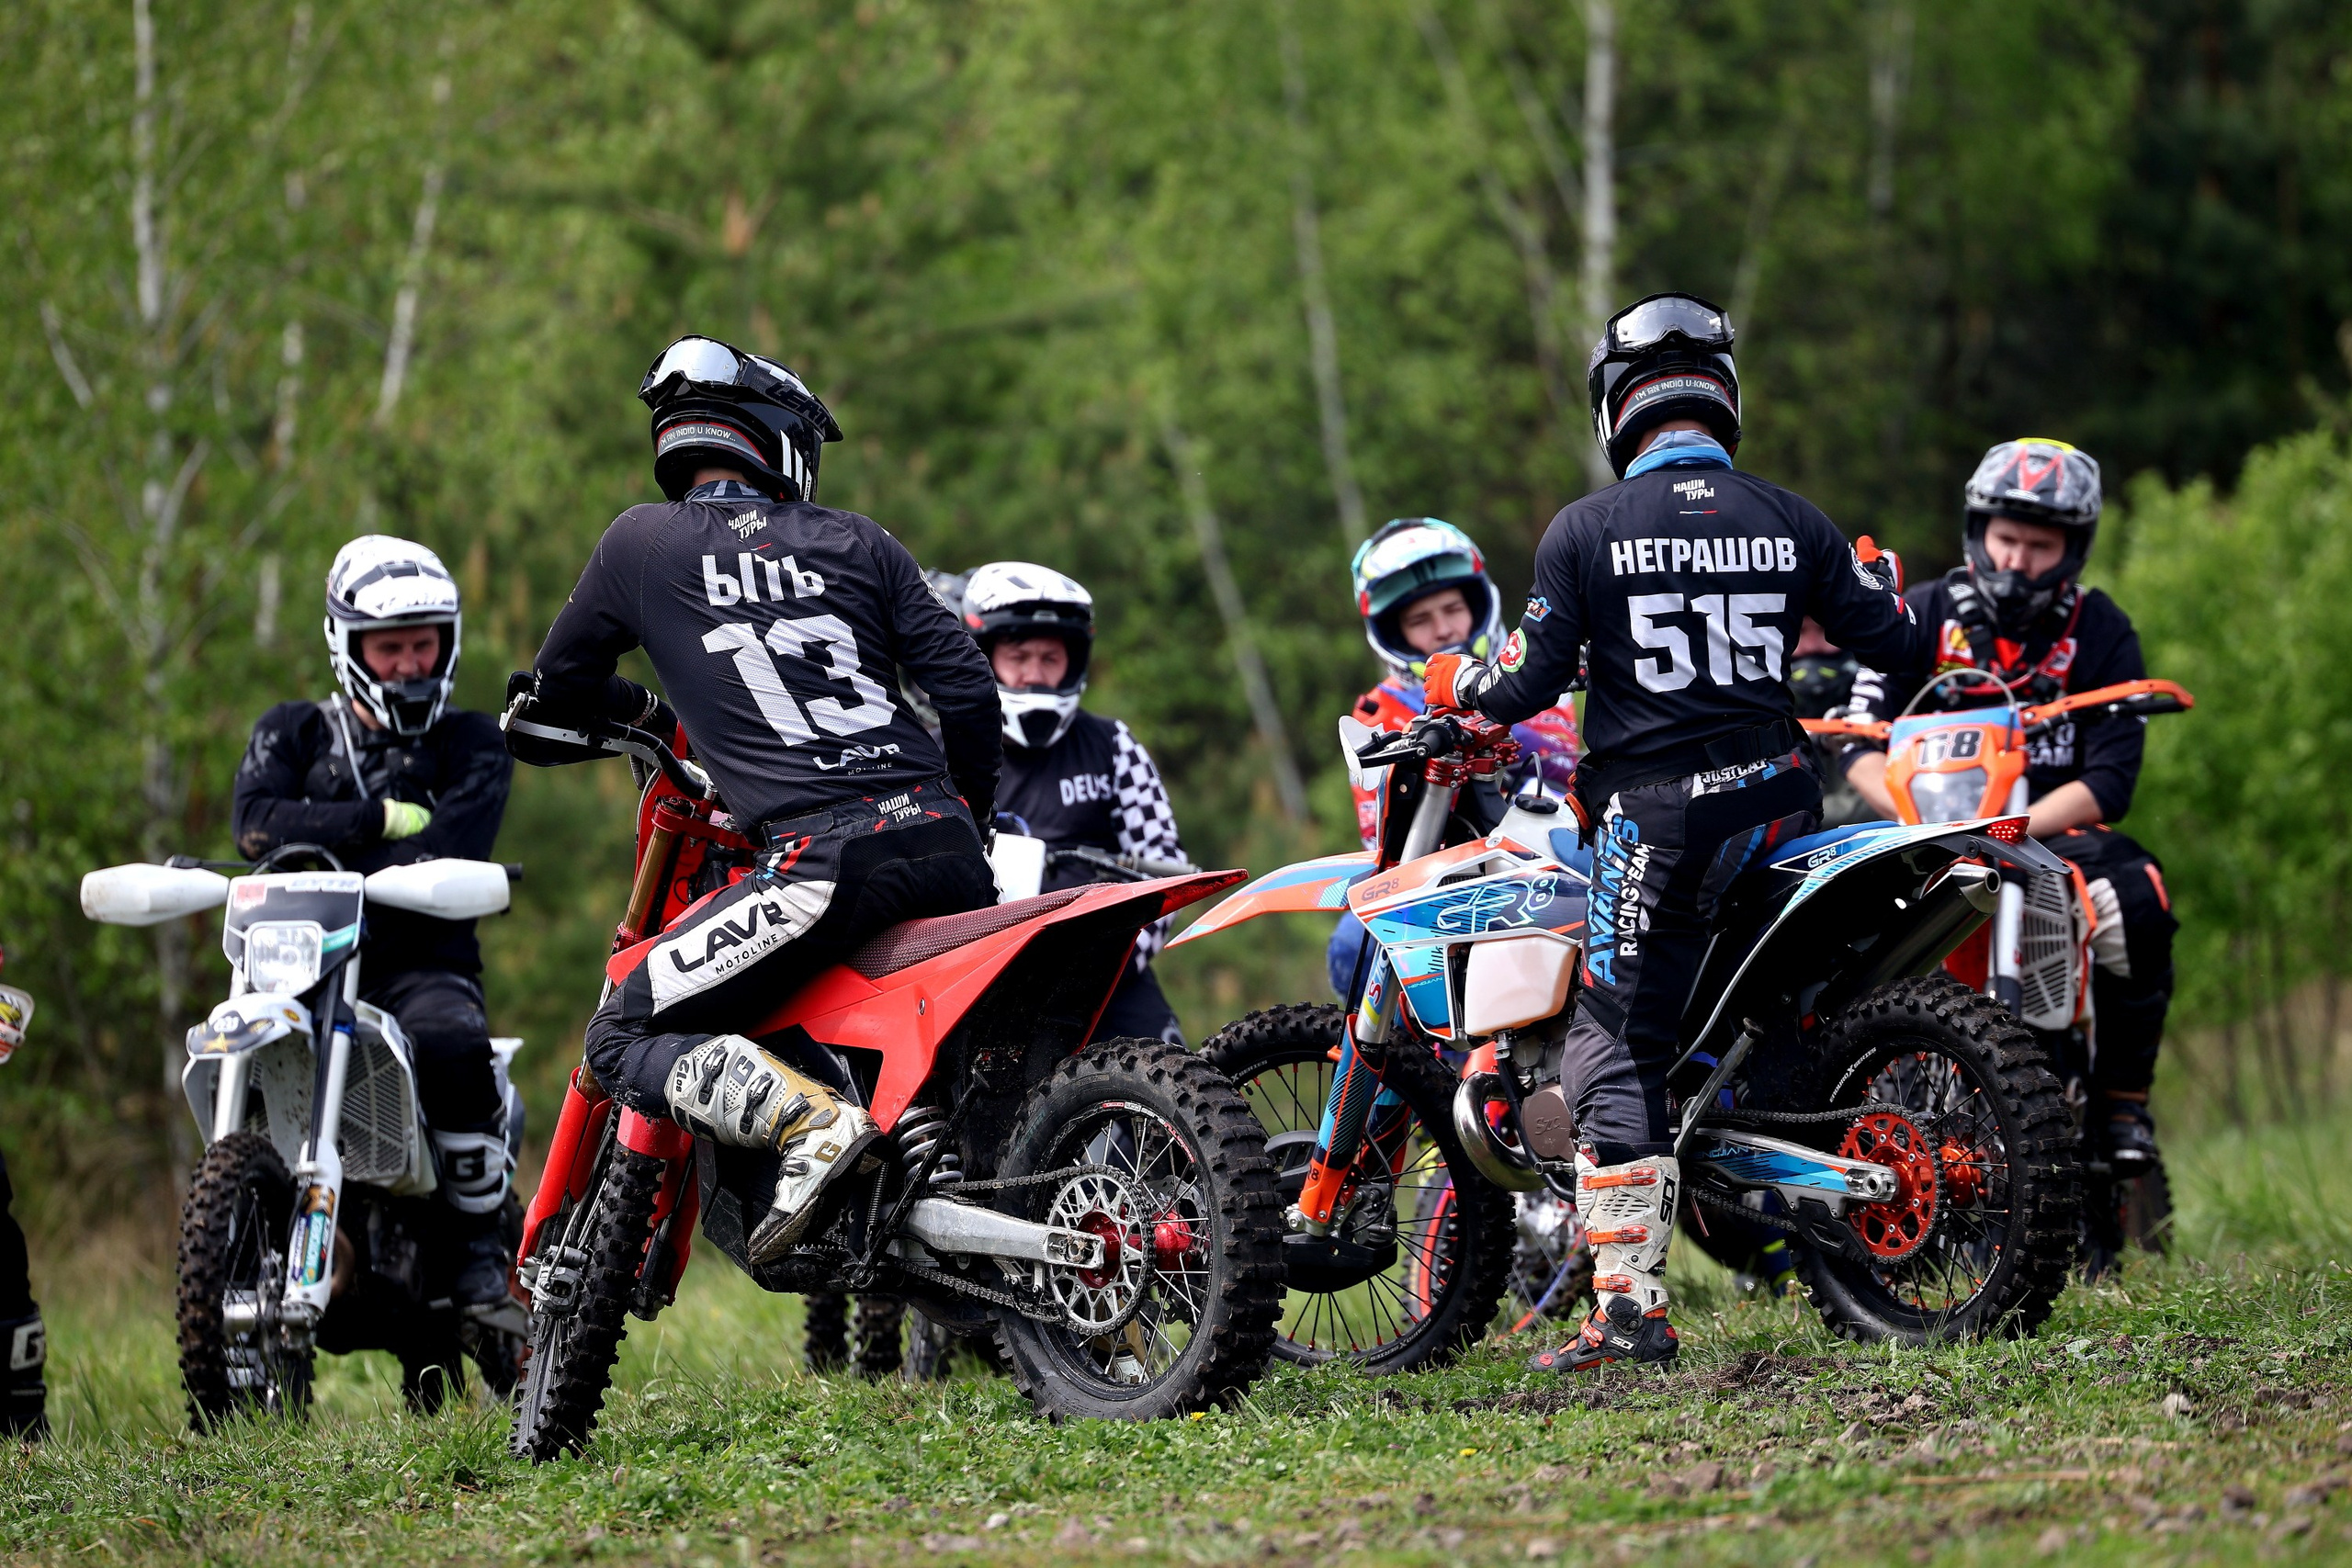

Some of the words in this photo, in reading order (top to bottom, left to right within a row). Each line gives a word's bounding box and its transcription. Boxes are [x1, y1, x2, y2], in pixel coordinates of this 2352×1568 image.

[1685, 379, 1691, 388] U
[1673, 479, 1705, 493] НАШИ
[1685, 487, 1714, 502] ТУРЫ
[739, 516, 767, 539] ТУРЫ
[1610, 536, 1797, 576] НЕГРАШОВ
[1627, 592, 1787, 693] 515
[701, 614, 898, 747] 13
[812, 742, 903, 771] LAVR
[1059, 773, 1113, 807] DEUS
[877, 793, 910, 815] НАШИ
[892, 803, 922, 823] ТУРЫ
[1807, 845, 1837, 869] GR8
[1361, 877, 1399, 902] GR8
[1618, 885, 1641, 957] RACING
[669, 901, 792, 974] LAVR
[715, 933, 778, 975] MOTOLINE
